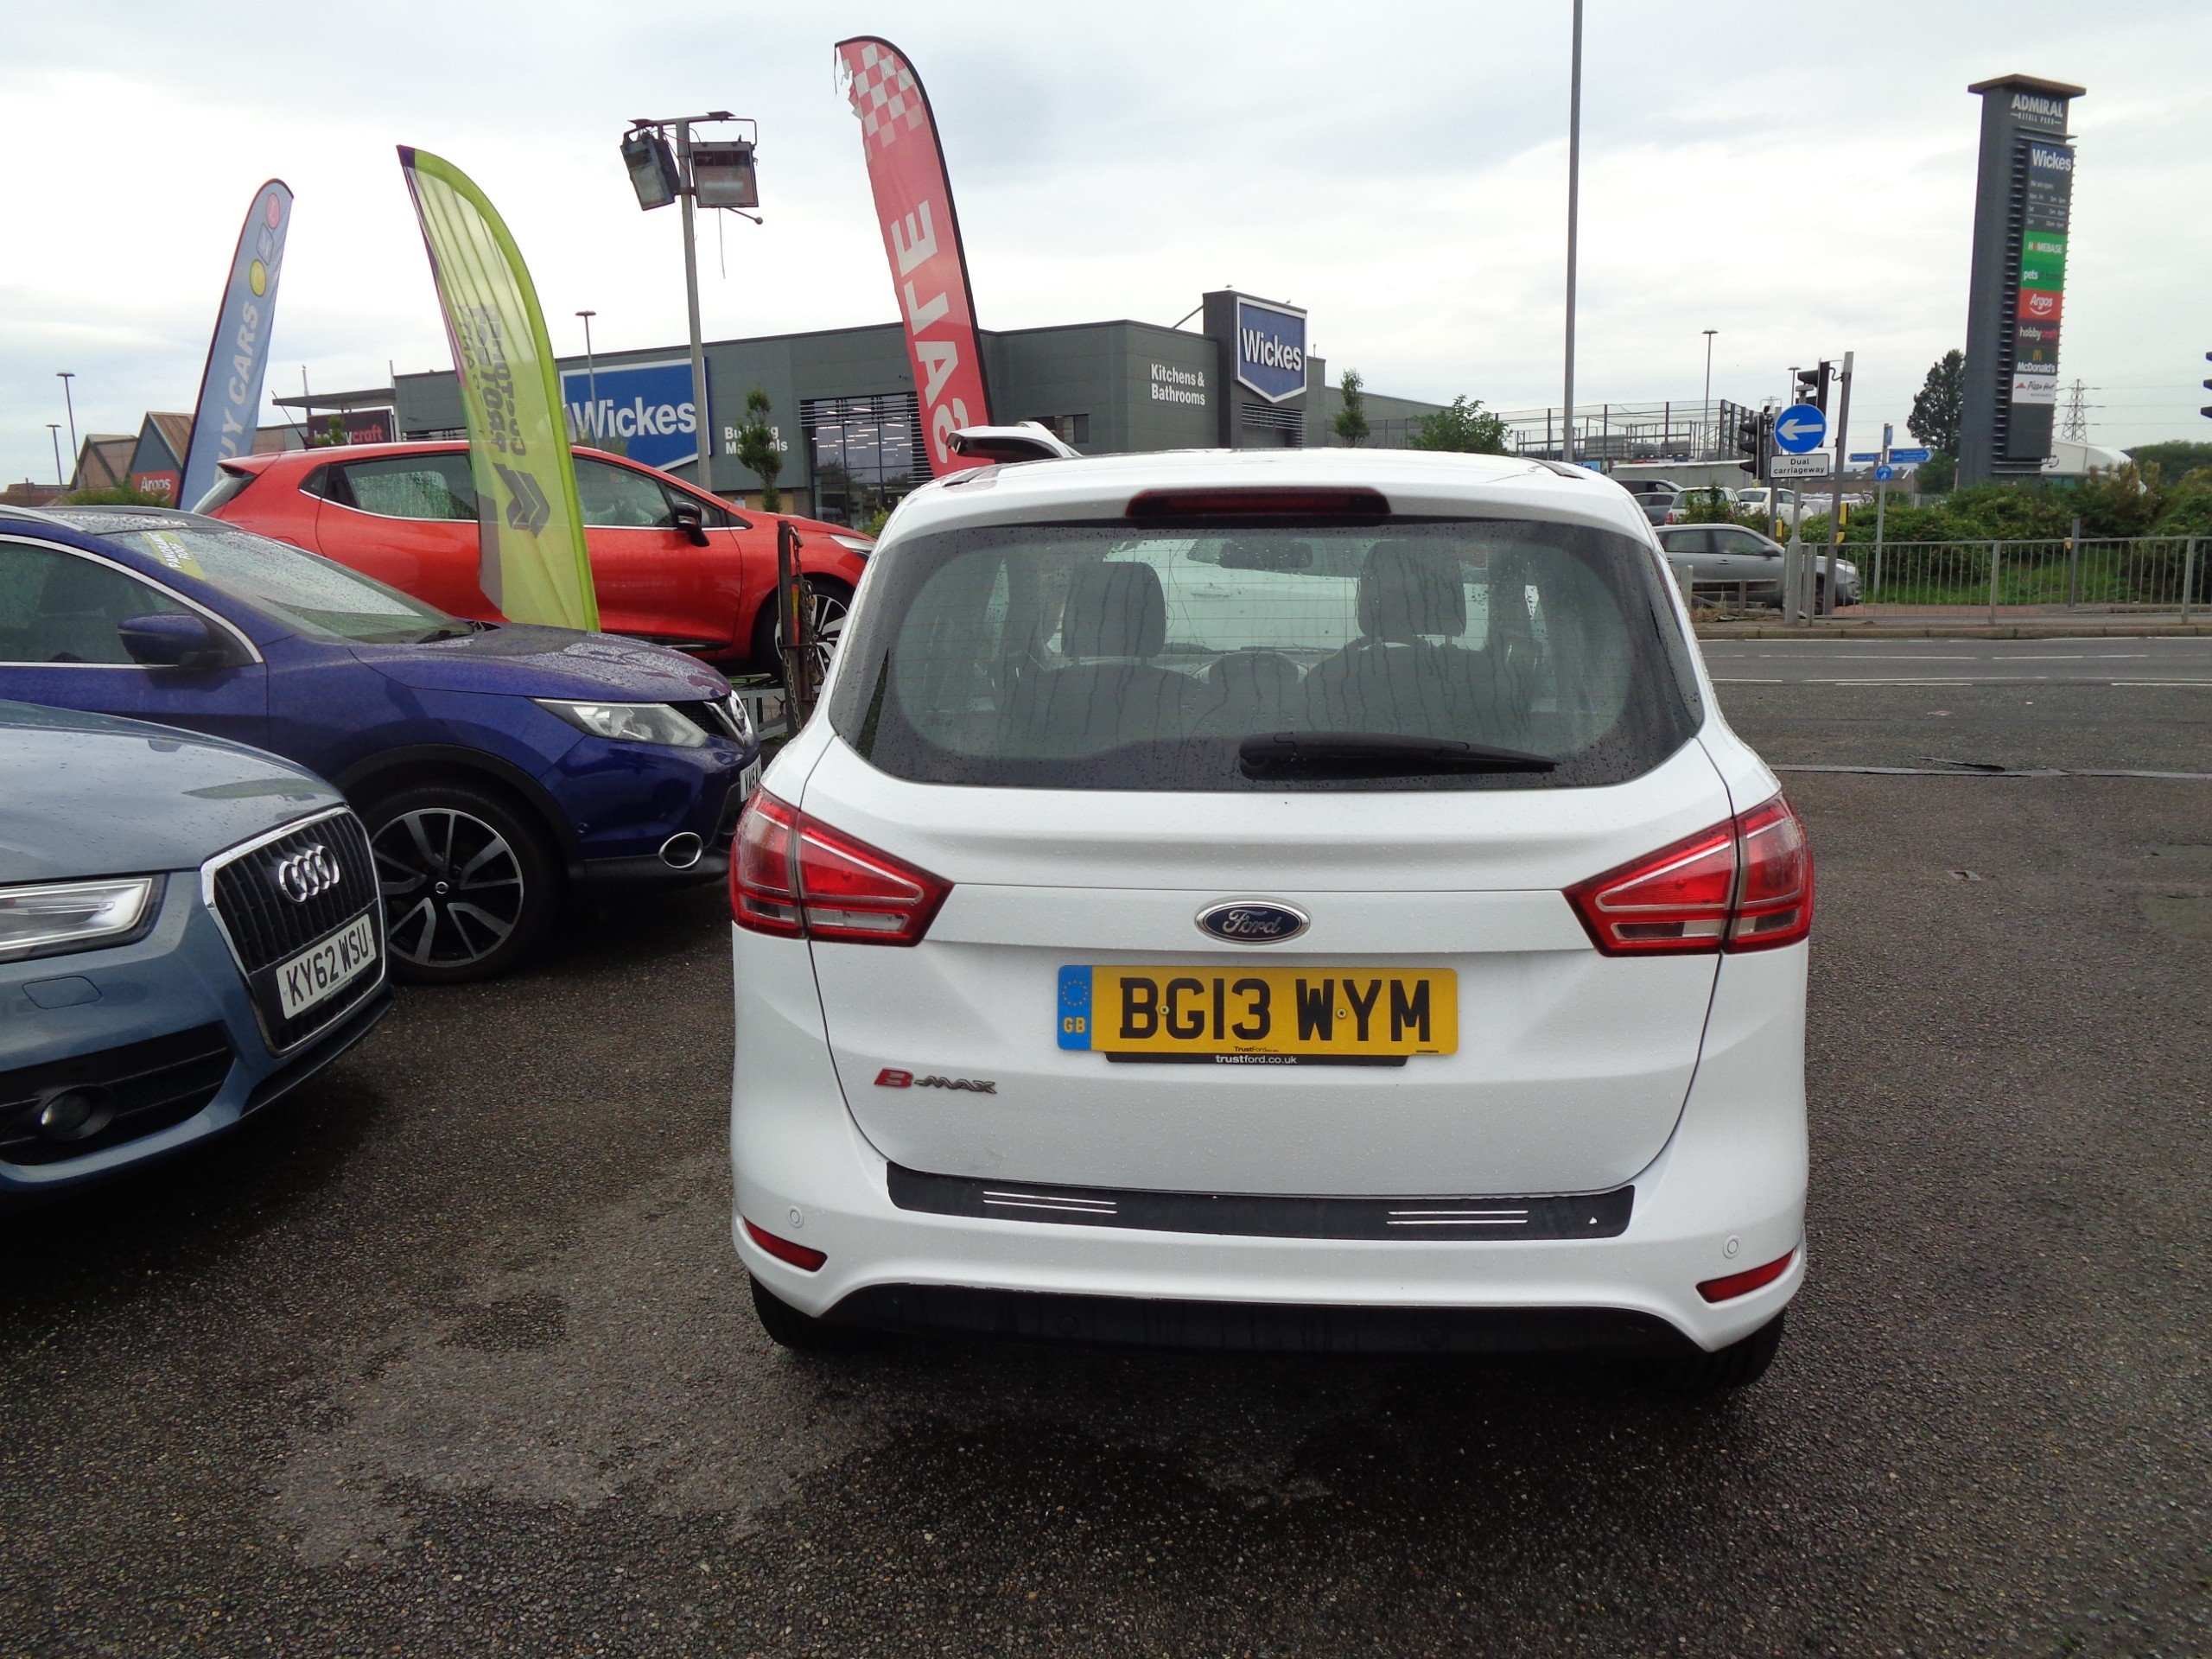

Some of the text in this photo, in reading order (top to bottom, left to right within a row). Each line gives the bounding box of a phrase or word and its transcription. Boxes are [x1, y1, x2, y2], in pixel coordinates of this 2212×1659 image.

[2012, 94, 2063, 118] ADMIRAL
[2032, 149, 2072, 171] Wickes
[2028, 242, 2063, 255] HOMEBASE
[2030, 294, 2053, 310] Argos
[230, 302, 258, 405] CARS
[1243, 327, 1303, 372] Wickes
[1151, 364, 1205, 388] Kitchens &
[2017, 361, 2056, 374] McDonald's
[1151, 384, 1205, 405] Bathrooms
[572, 397, 696, 439] Wickes
[1773, 467, 1826, 476] carriageway
[1790, 457, 1810, 466] Dual
[1222, 909, 1281, 934] Ford
[286, 946, 340, 1007] KY62
[338, 923, 369, 973] WSU
[1119, 977, 1431, 1042] BG13 WYM
[1063, 1016, 1086, 1033] GB
[1215, 1054, 1297, 1065] trustford.co.uk
